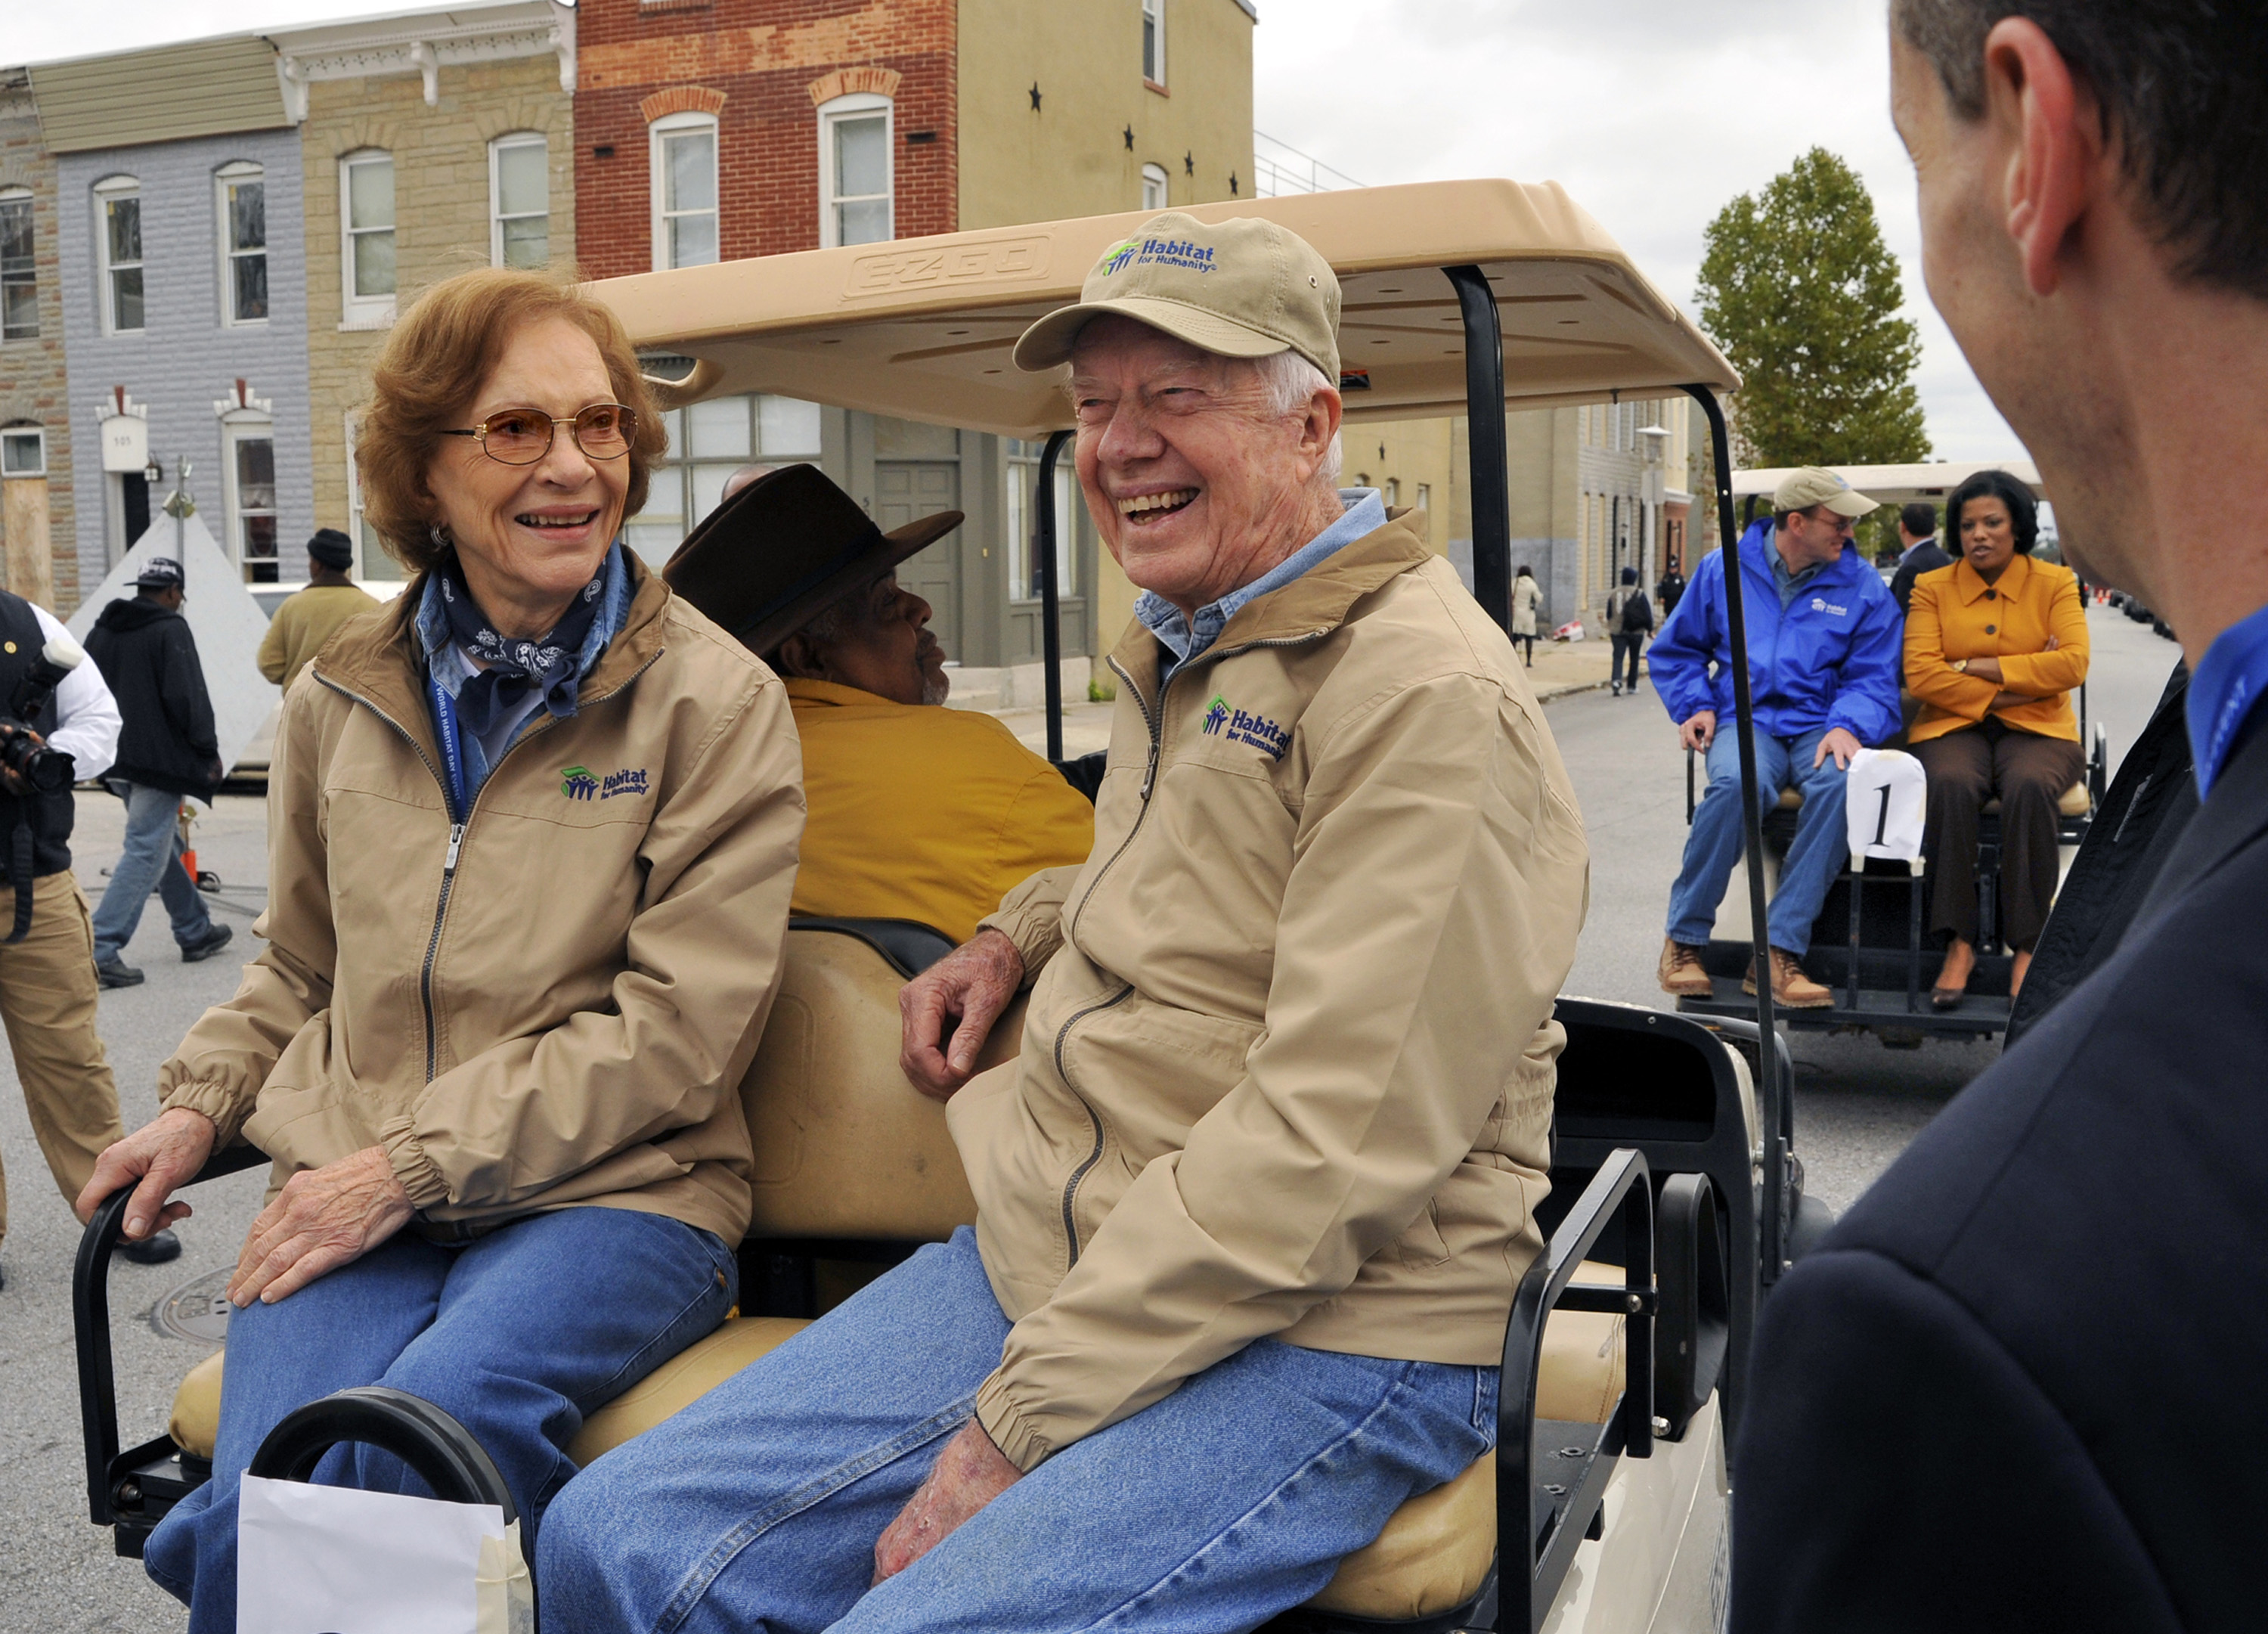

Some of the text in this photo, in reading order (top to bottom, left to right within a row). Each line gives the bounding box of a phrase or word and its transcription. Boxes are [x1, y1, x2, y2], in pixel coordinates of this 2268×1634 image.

[1138, 256, 1153, 265] for
[1142, 239, 1213, 262] Habitat
[436, 687, 460, 800] WORLD HABITAT DAY EVENT
[1225, 728, 1241, 740] for
[603, 769, 647, 791] Habitat
[600, 792, 611, 800] for
[1868, 783, 1892, 848] 1
